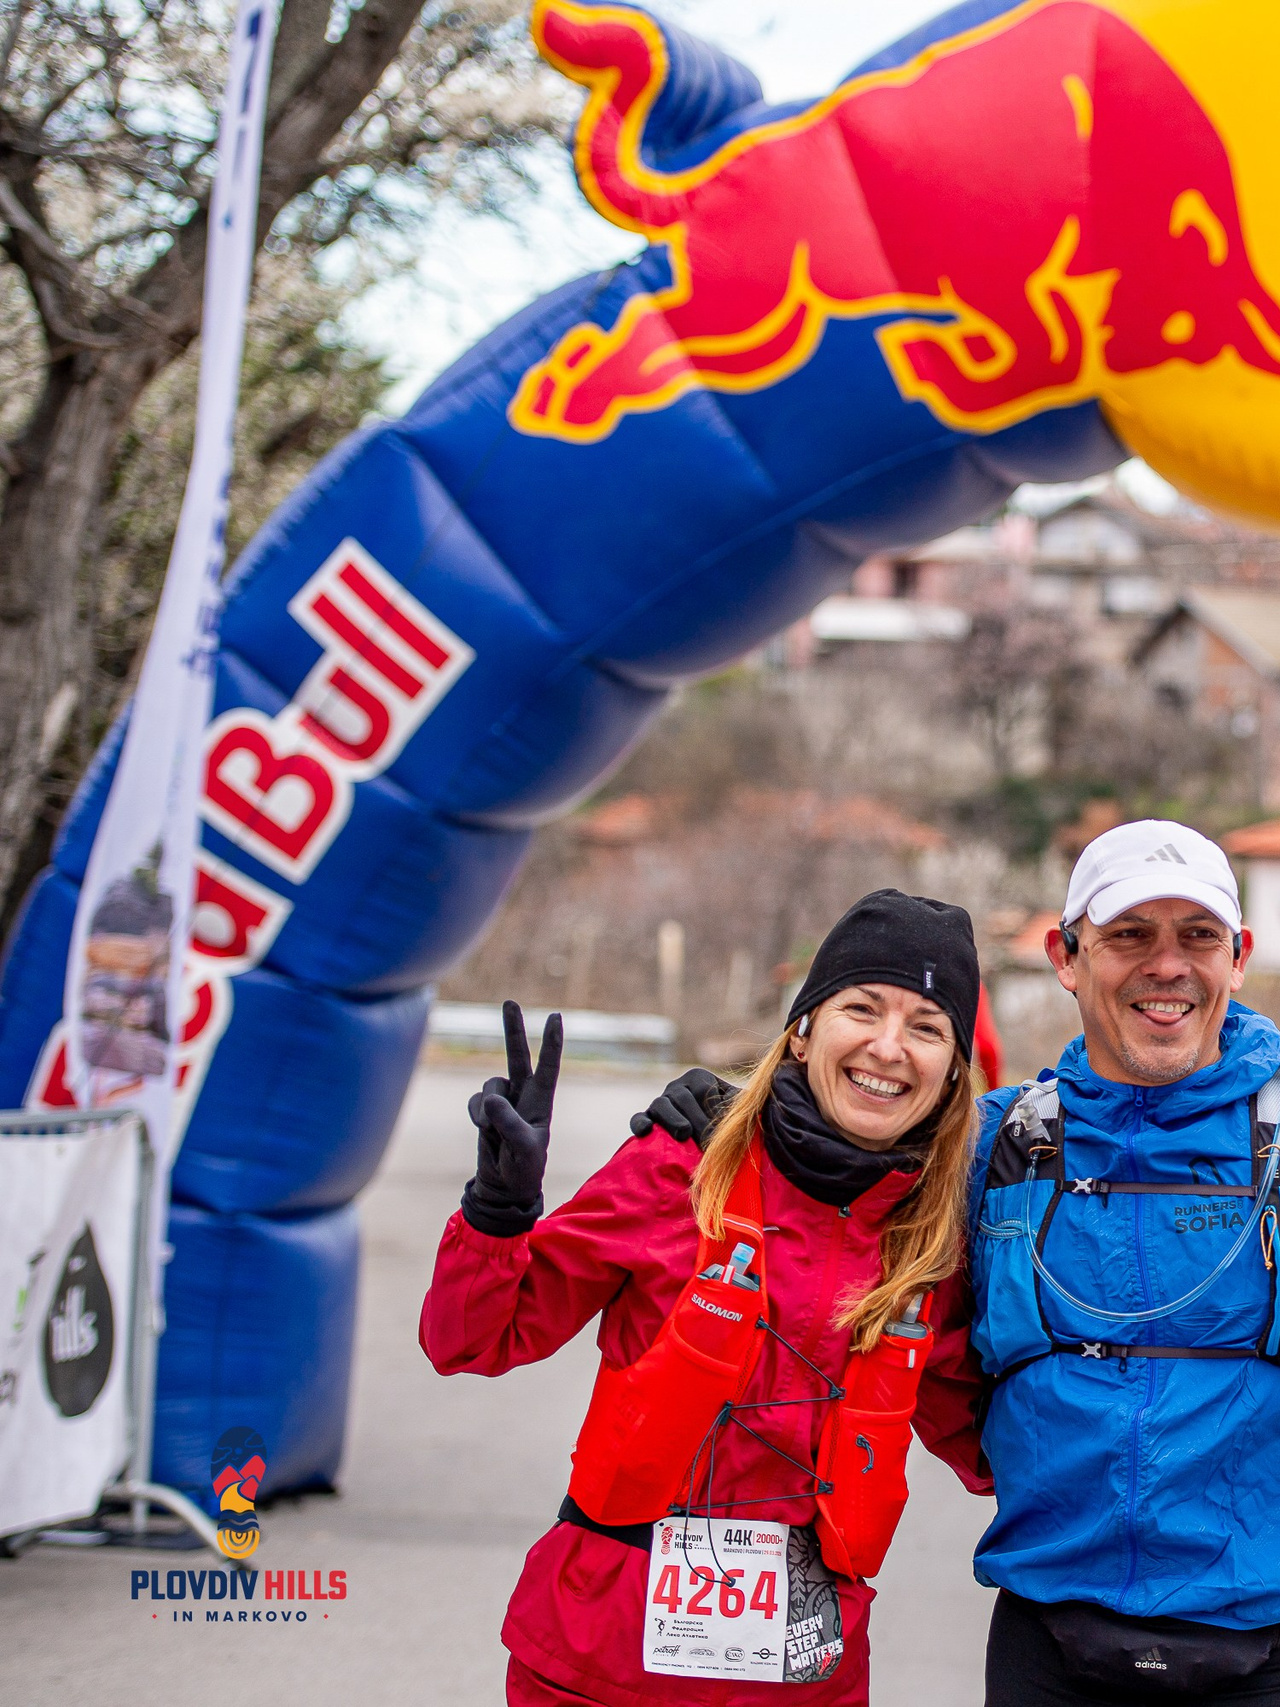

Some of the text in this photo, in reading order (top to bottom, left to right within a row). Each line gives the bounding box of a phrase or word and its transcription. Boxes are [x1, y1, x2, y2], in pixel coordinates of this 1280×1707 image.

[201, 552, 462, 868] Bull
[1174, 1201, 1237, 1216] RUNNERS
[1174, 1212, 1245, 1234] SOFIA
[691, 1293, 743, 1322] SALOMON
[675, 1533, 704, 1542] PLVDIV
[723, 1528, 753, 1546] 44K
[652, 1564, 779, 1620] 4264
[786, 1613, 824, 1641] EVERY
[785, 1631, 819, 1656] STEP
[788, 1637, 844, 1671] MATTERS
[1134, 1661, 1167, 1670] adidas
